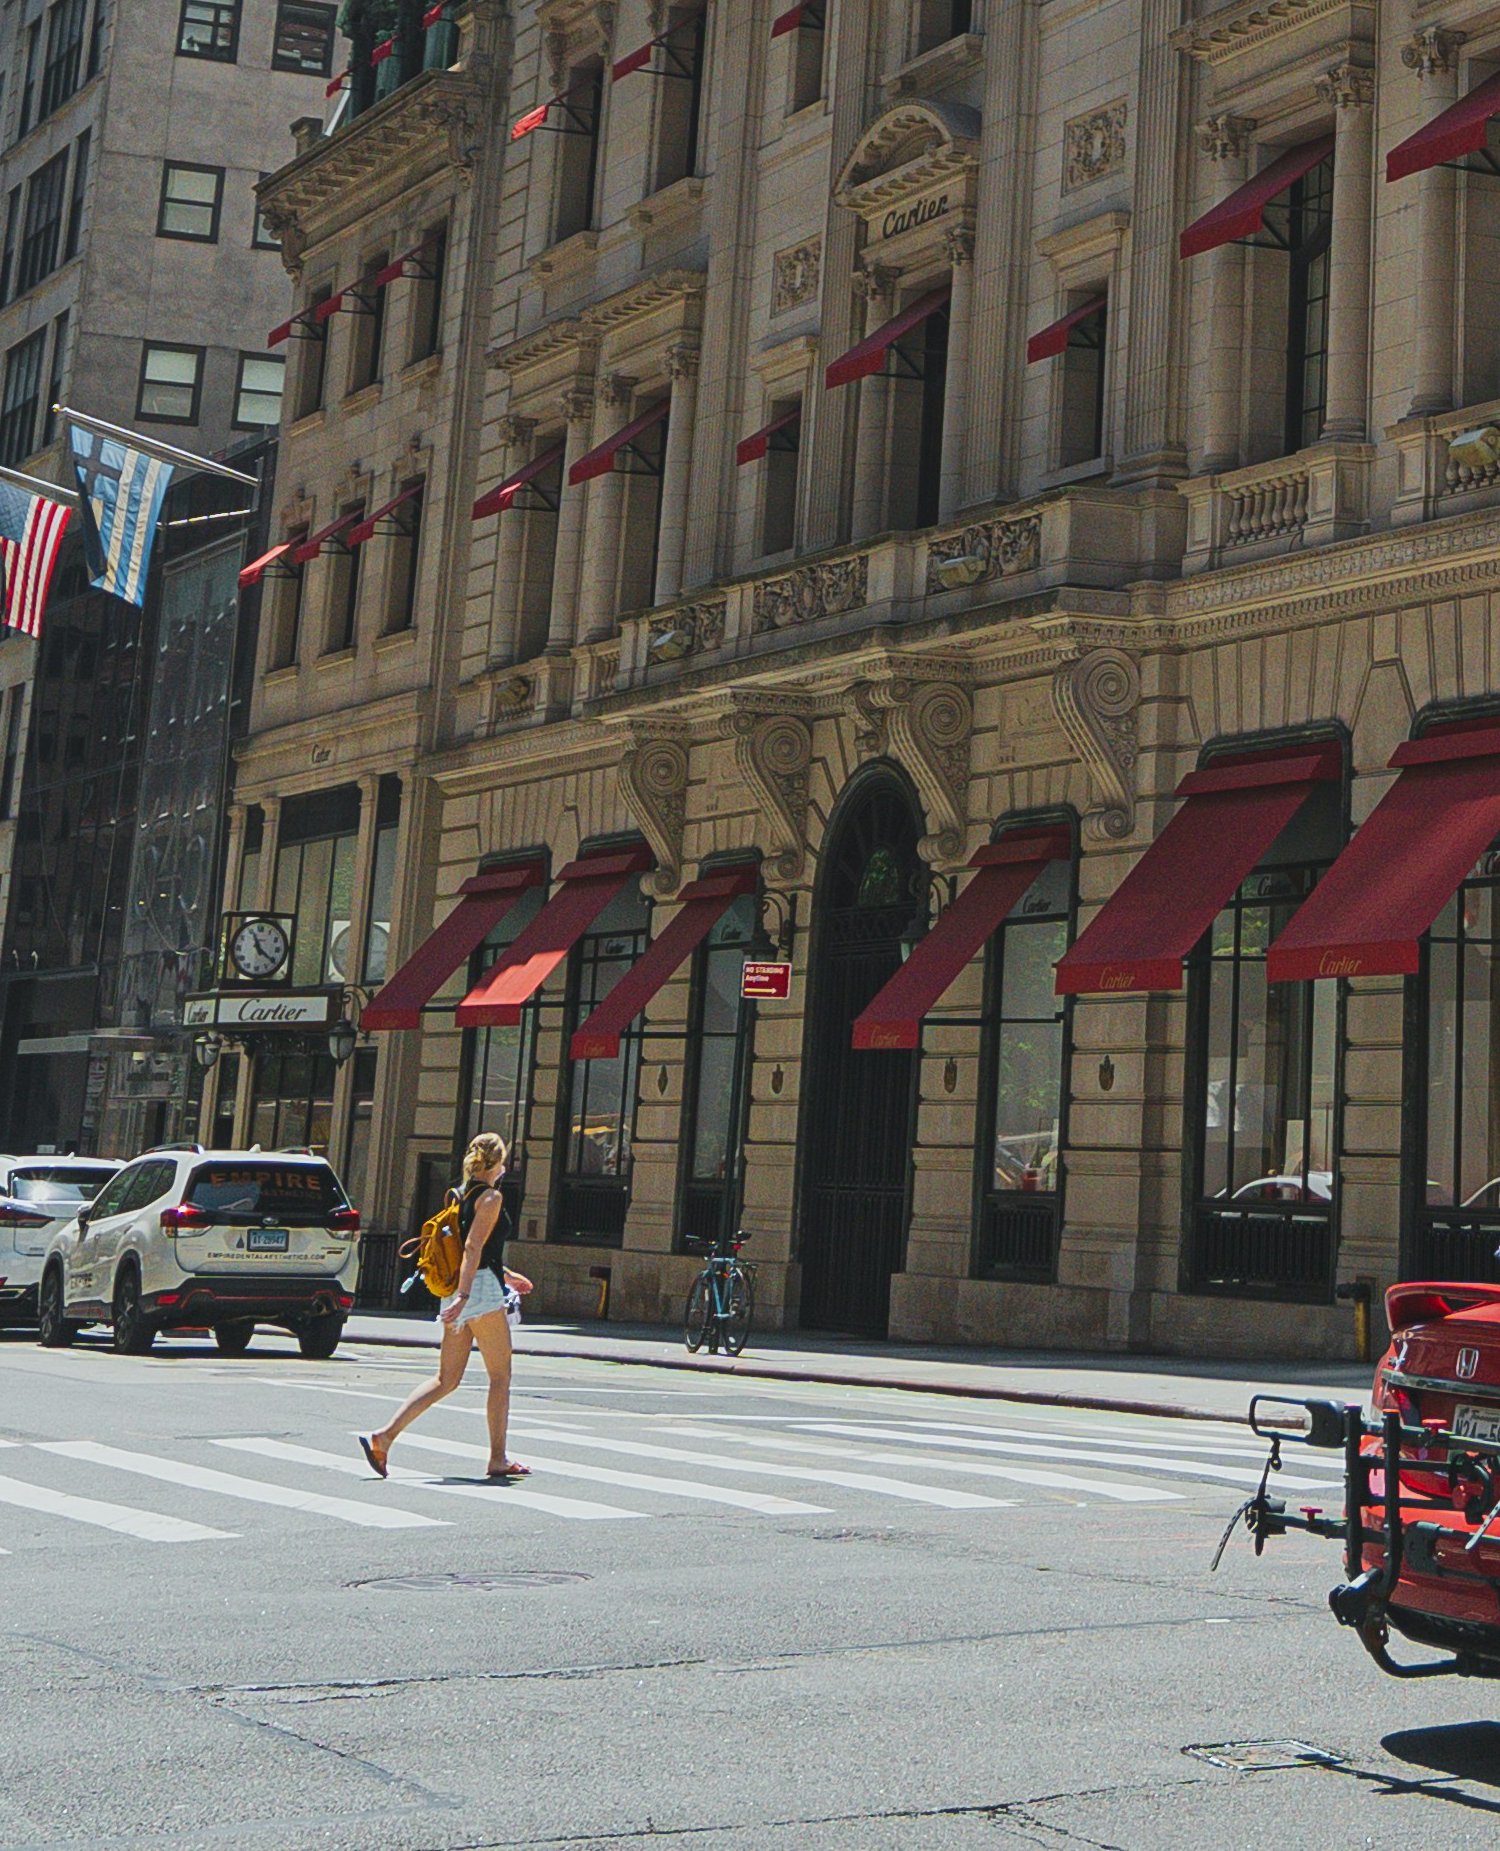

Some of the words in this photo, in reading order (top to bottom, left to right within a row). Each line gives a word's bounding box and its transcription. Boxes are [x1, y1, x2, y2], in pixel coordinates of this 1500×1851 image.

[882, 194, 950, 239] Cartier
[1320, 951, 1362, 976] Cartier
[1100, 967, 1136, 990] Cartier
[237, 998, 307, 1021] Cartier
[210, 1171, 321, 1190] EMPIRE
